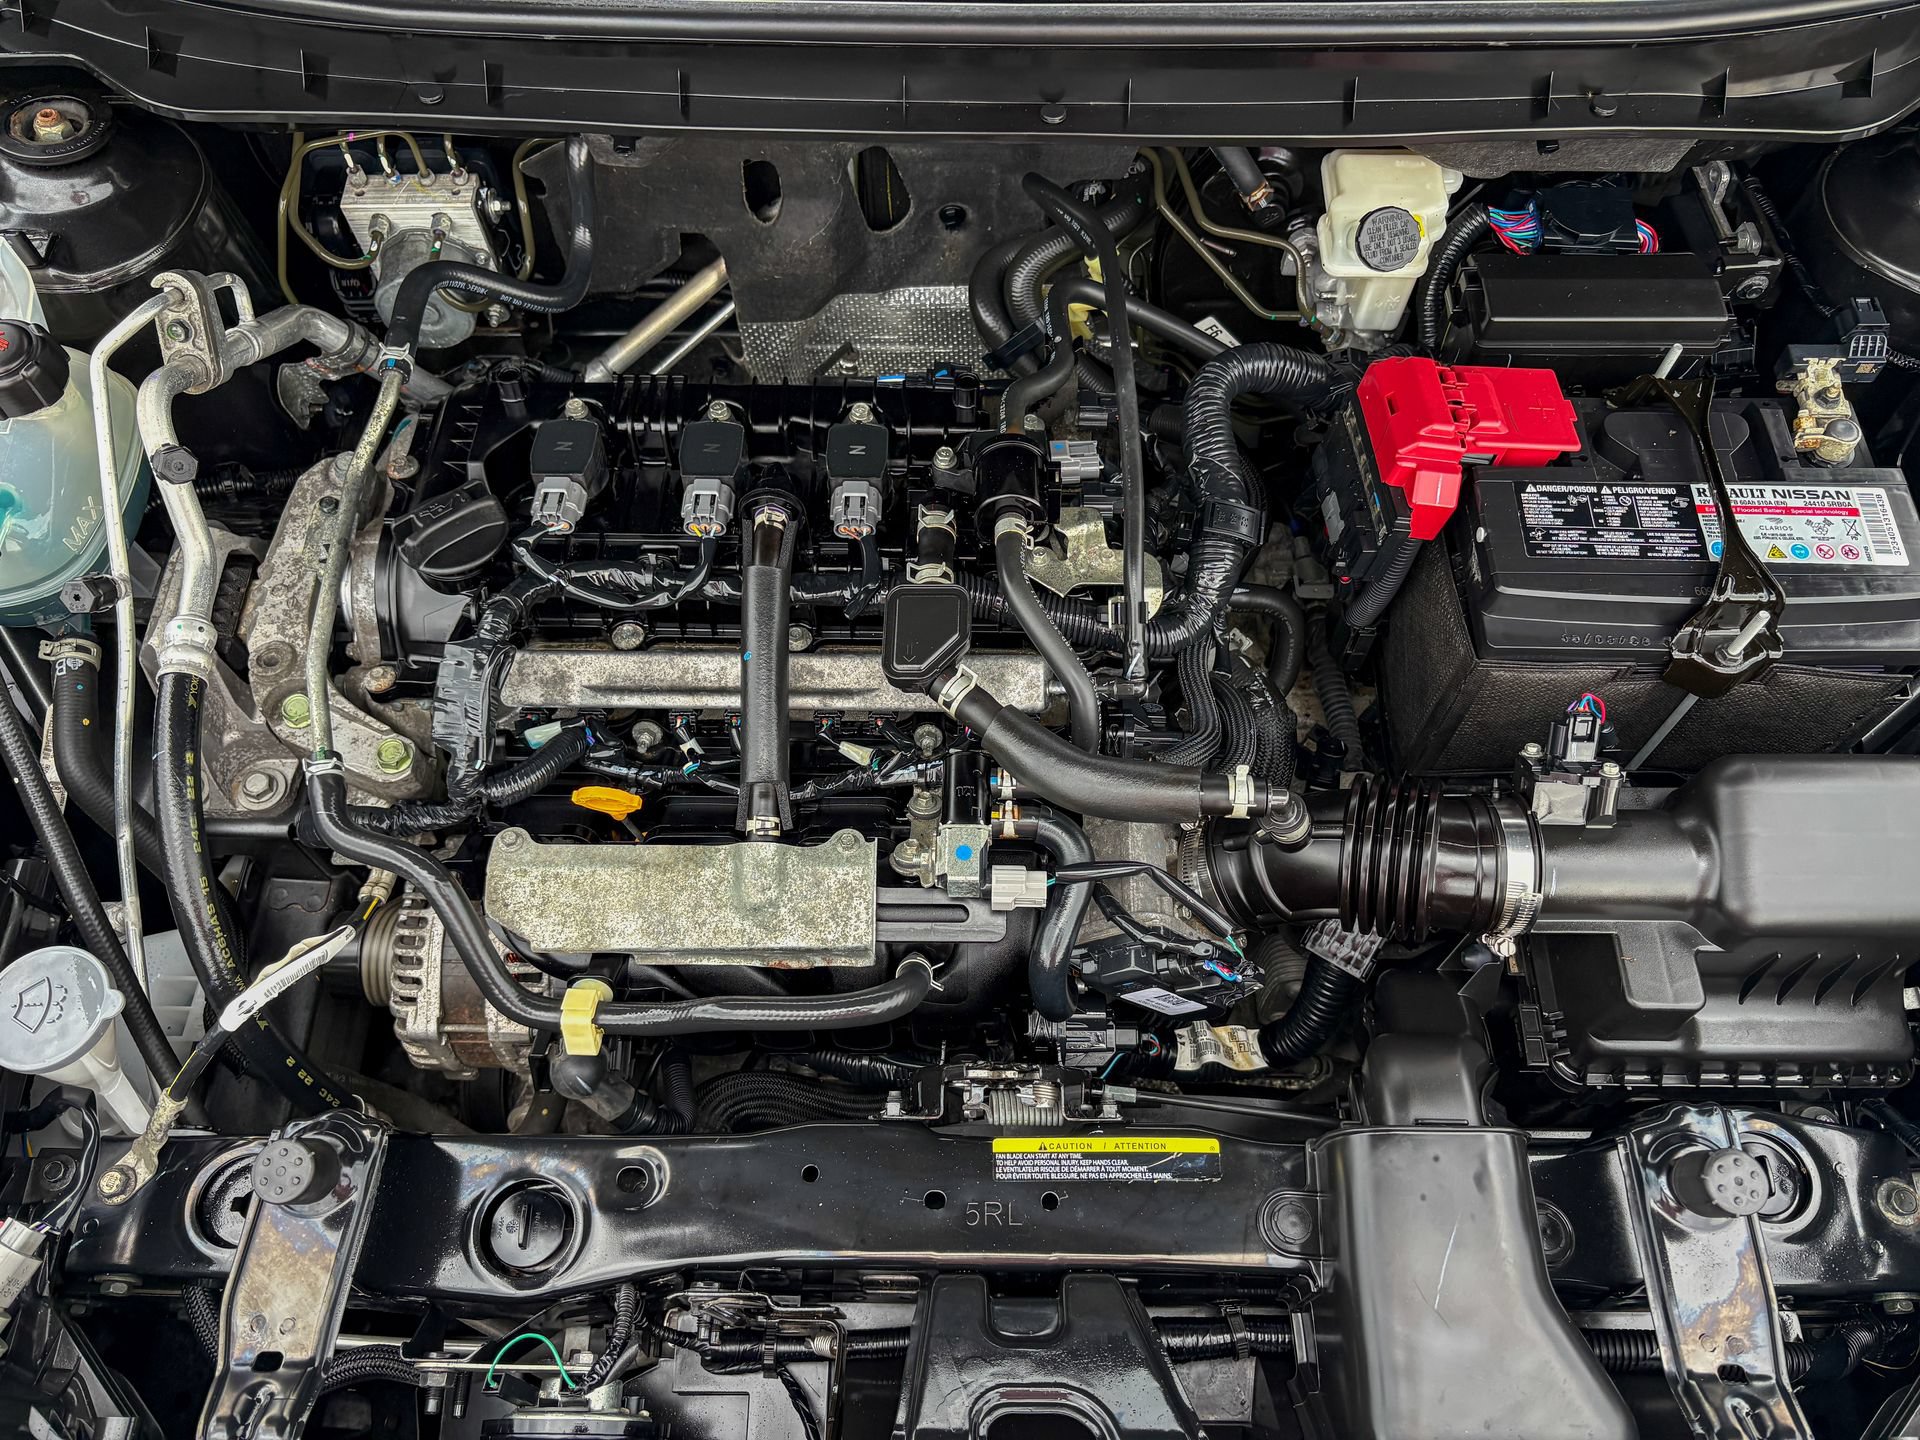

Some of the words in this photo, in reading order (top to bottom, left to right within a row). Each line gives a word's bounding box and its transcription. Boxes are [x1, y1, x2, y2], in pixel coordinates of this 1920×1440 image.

[1372, 213, 1402, 226] WARNING
[1536, 485, 1598, 494] DANGER/POISON
[1612, 486, 1677, 495] PELIGRO/VENENO
[1696, 487, 1765, 499] RAULT
[1772, 488, 1850, 501] NISSAN
[1791, 508, 1812, 516] Special
[62, 495, 103, 553] MAX
[298, 1069, 315, 1087] 22
[1049, 1142, 1093, 1150] CAUTION
[1114, 1142, 1167, 1150] ATTENTION
[965, 1202, 1024, 1227] 5RL
